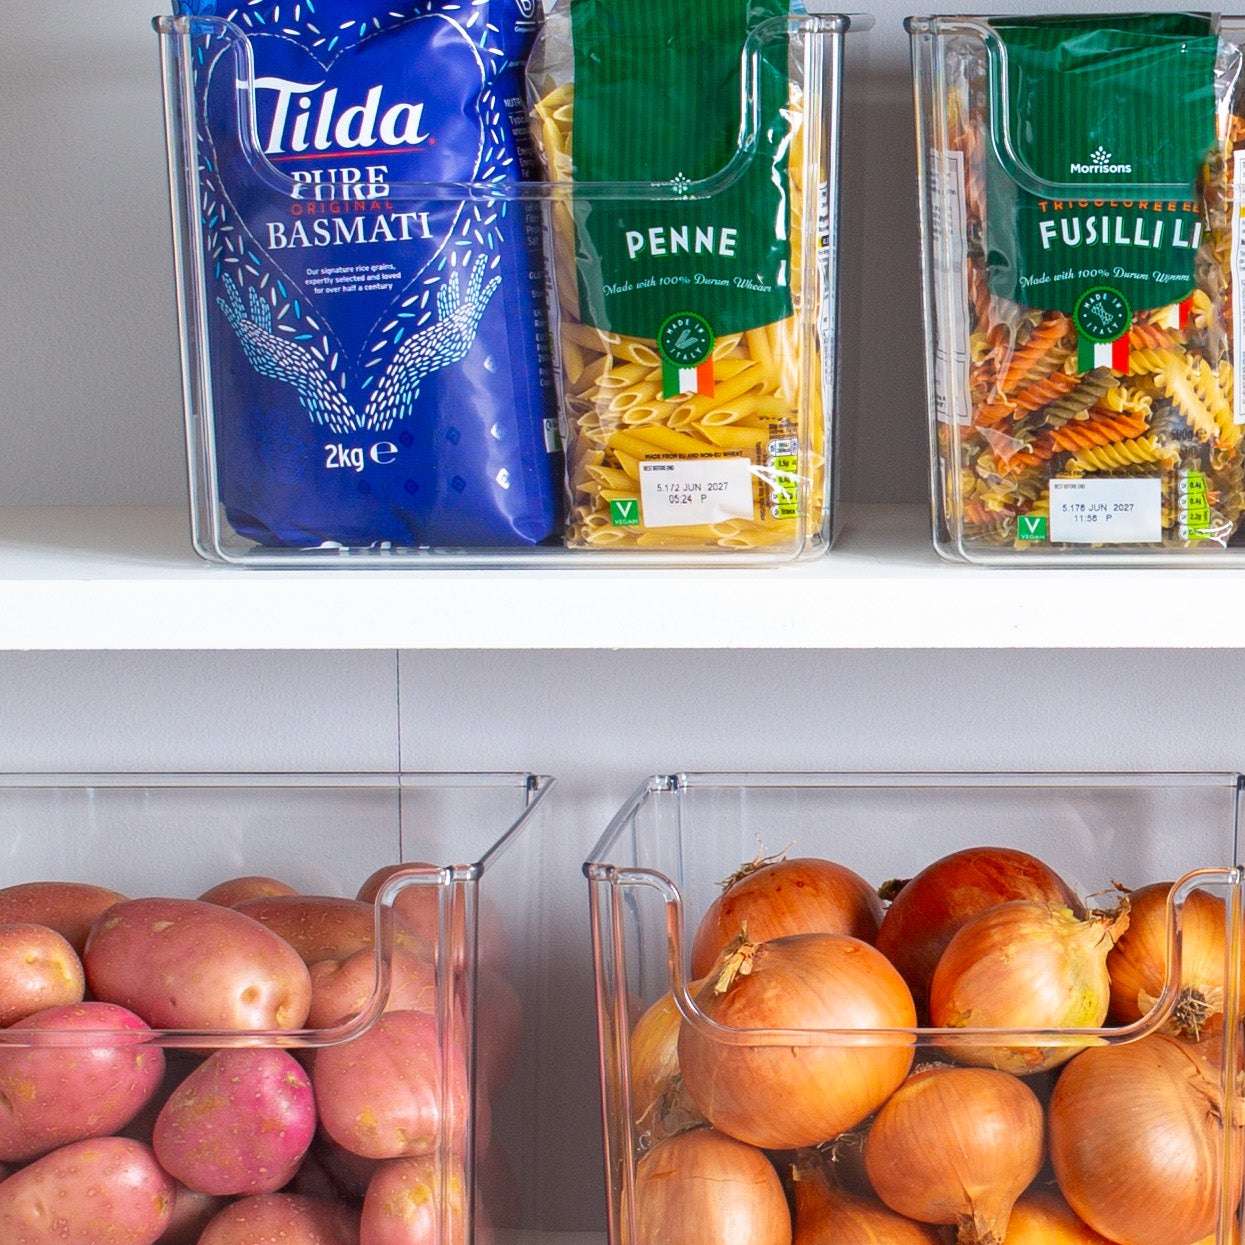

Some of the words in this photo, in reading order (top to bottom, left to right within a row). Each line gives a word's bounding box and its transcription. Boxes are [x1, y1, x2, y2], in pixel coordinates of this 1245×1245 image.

[236, 76, 430, 155] Tilda
[1070, 162, 1132, 174] Morrisons
[290, 200, 394, 217] ORIGINAL
[266, 211, 434, 250] BASMATI
[1039, 215, 1163, 249] FUSILLI
[625, 225, 738, 260] PENNE
[367, 273, 380, 281] and
[602, 281, 633, 296] Made
[636, 275, 656, 289] with
[659, 275, 690, 286] 100%
[694, 272, 730, 287] Durum
[1019, 272, 1051, 288] Made
[1053, 268, 1074, 282] with
[1078, 268, 1110, 278] 100%
[1113, 266, 1149, 281] Durum
[1083, 293, 1107, 309] MADE
[1112, 297, 1122, 309] IN
[666, 318, 690, 335] MADE
[694, 323, 705, 334] IN
[1086, 322, 1119, 335] ITALY
[670, 347, 702, 361] ITALY
[325, 444, 364, 472] 2kg
[682, 483, 702, 492] JUN
[707, 482, 728, 492] 2027
[700, 494, 707, 503] P
[1088, 503, 1108, 512] JUN
[1113, 503, 1134, 512] 2027
[1106, 514, 1113, 522] P
